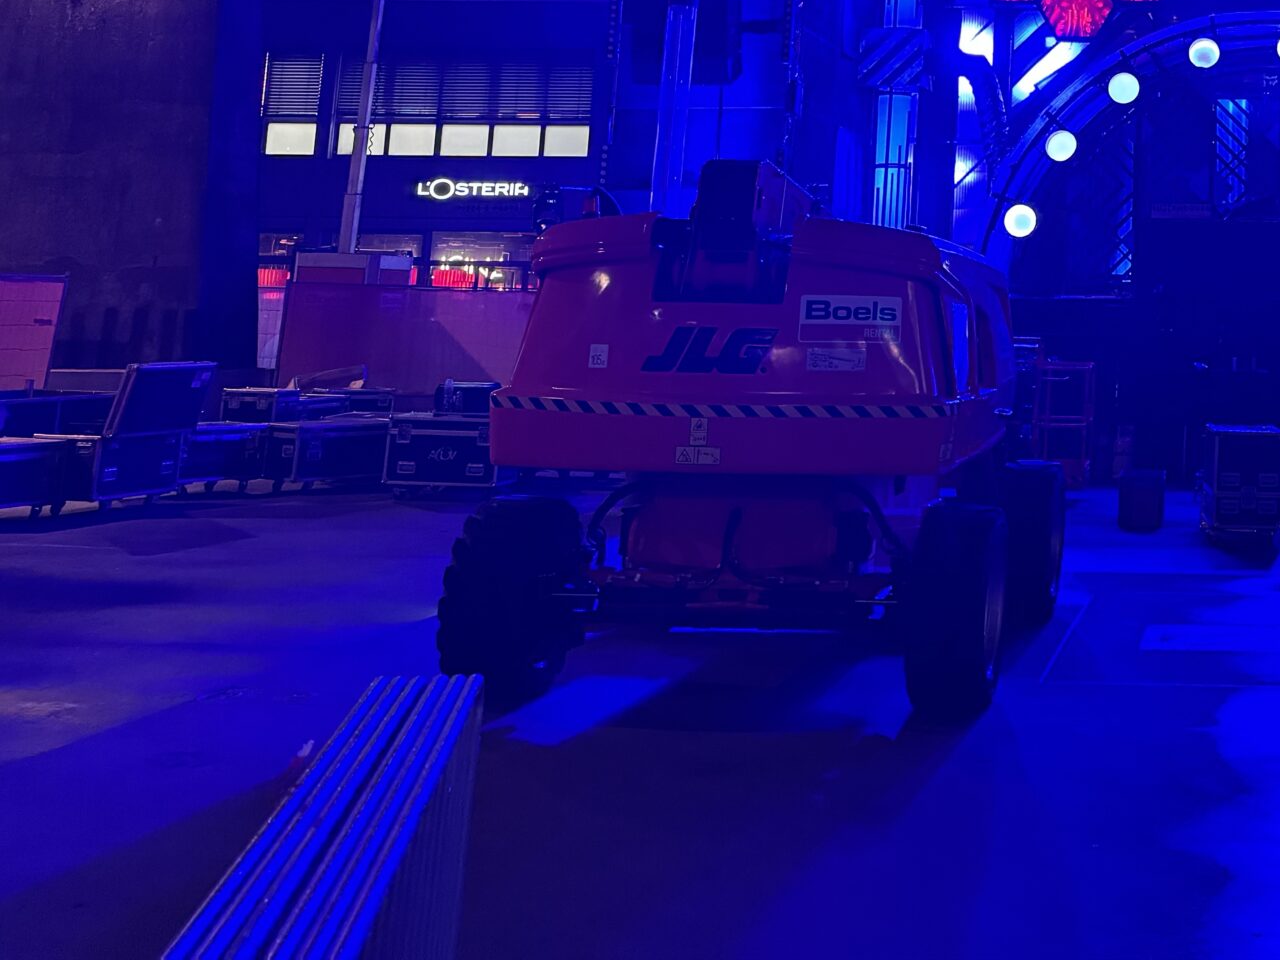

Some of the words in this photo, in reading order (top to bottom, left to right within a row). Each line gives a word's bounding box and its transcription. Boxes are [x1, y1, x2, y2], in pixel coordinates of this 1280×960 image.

[417, 178, 529, 200] L'OSTERIA
[805, 300, 897, 322] Boels
[640, 326, 780, 374] JLG
